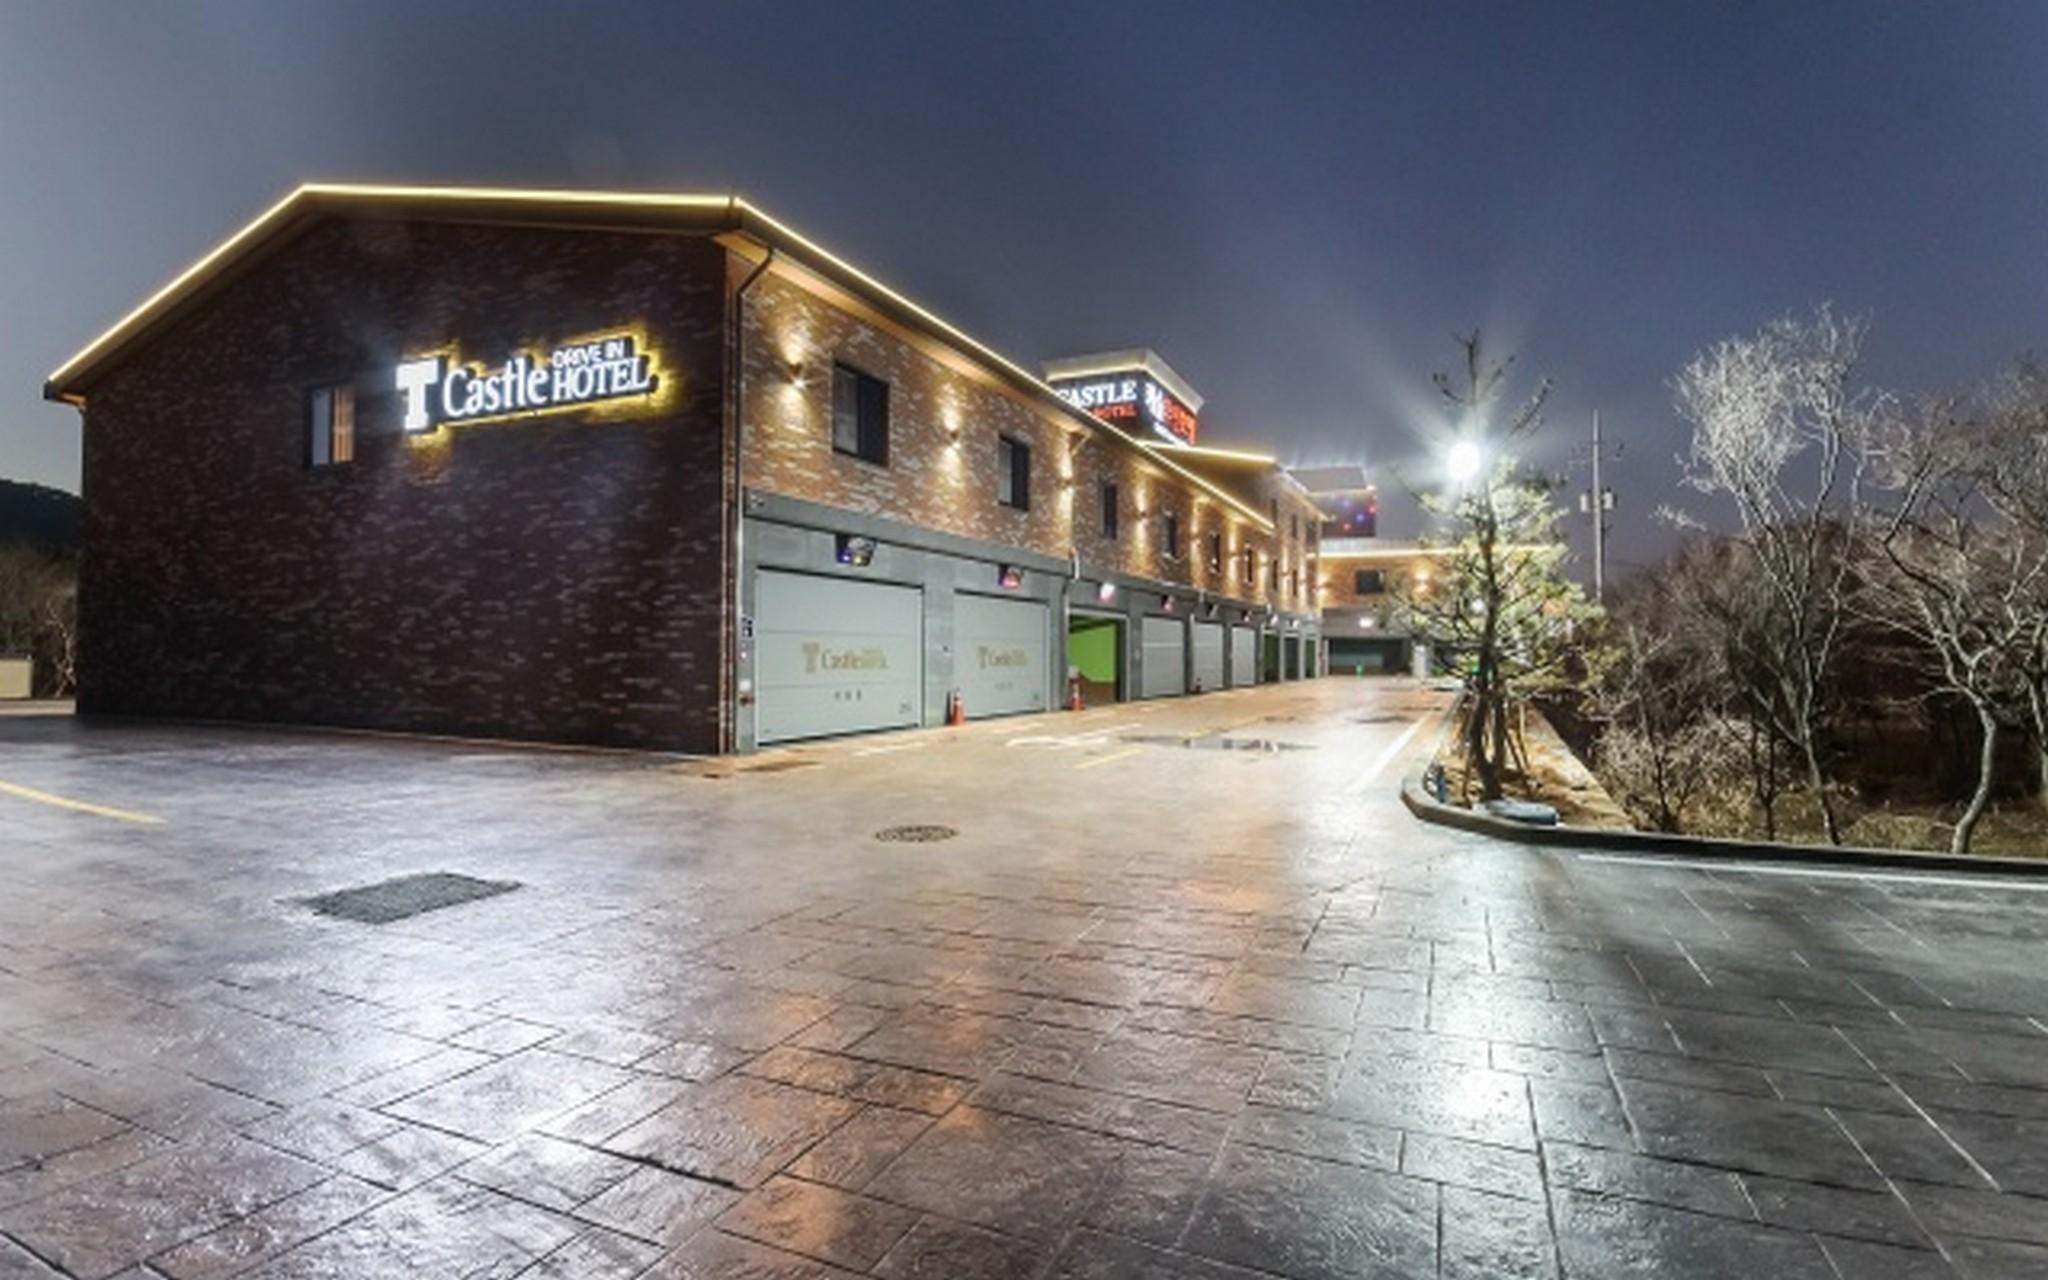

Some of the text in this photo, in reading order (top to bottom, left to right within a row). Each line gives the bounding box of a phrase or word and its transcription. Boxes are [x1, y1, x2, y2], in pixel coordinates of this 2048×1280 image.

[552, 340, 624, 367] DRIVE IN
[396, 357, 650, 430] T Castle HOTEL
